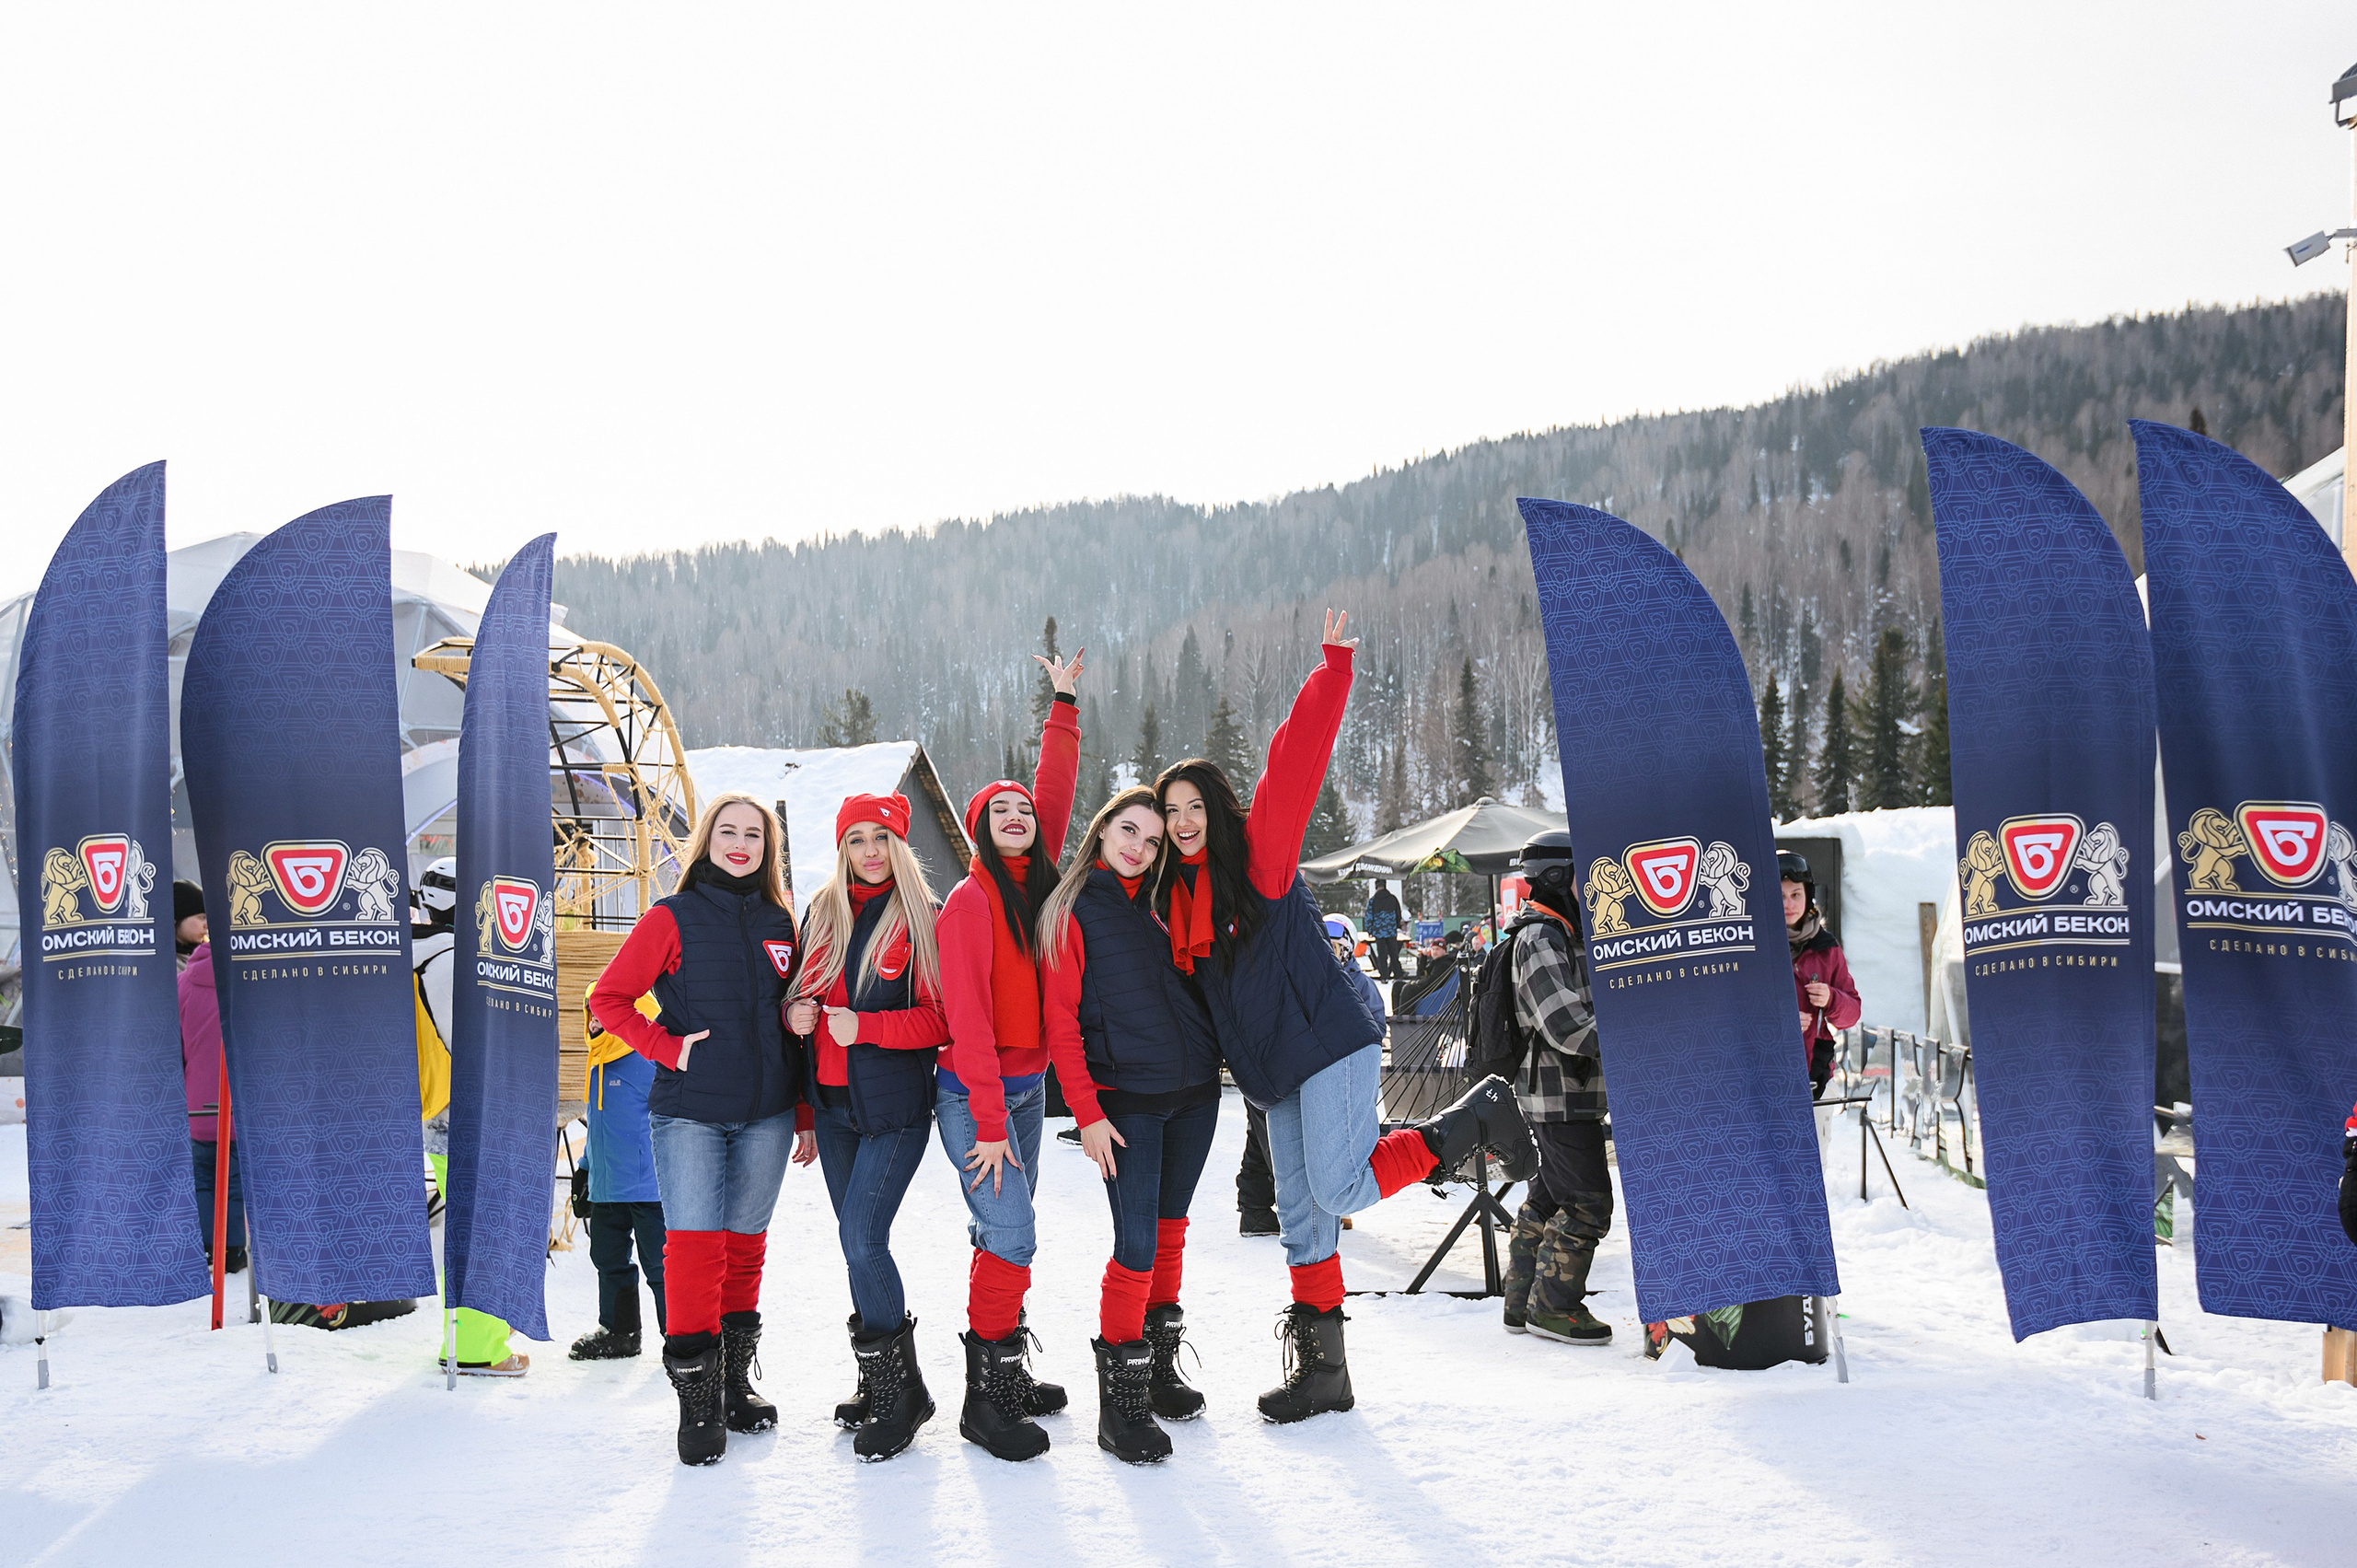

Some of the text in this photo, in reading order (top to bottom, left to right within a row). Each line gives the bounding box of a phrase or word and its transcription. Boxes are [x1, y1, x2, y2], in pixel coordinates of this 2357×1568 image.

[2187, 900, 2304, 922] ОМСКИЙ
[41, 925, 115, 951] ОМСКИЙ
[230, 928, 401, 950] ОМСКИЙ БЕКОН
[1964, 913, 2130, 945] ОМСКИЙ БЕКОН
[1593, 925, 1754, 961] ОМСКИЙ БЕКОН
[2210, 939, 2289, 957] СДЕЛАНО
[2298, 946, 2305, 957] В
[57, 966, 109, 981] СДЕЛАНО
[110, 965, 115, 976] В
[242, 965, 388, 981] СДЕЛАНО В СИБИРИ
[1609, 961, 1739, 990] СДЕЛАНО В СИБИРИ
[1975, 955, 2118, 977] СДЕЛАНО В СИБИРИ
[523, 970, 554, 990] БЕК
[516, 1002, 520, 1012] В
[1802, 1295, 1814, 1345] БУД
